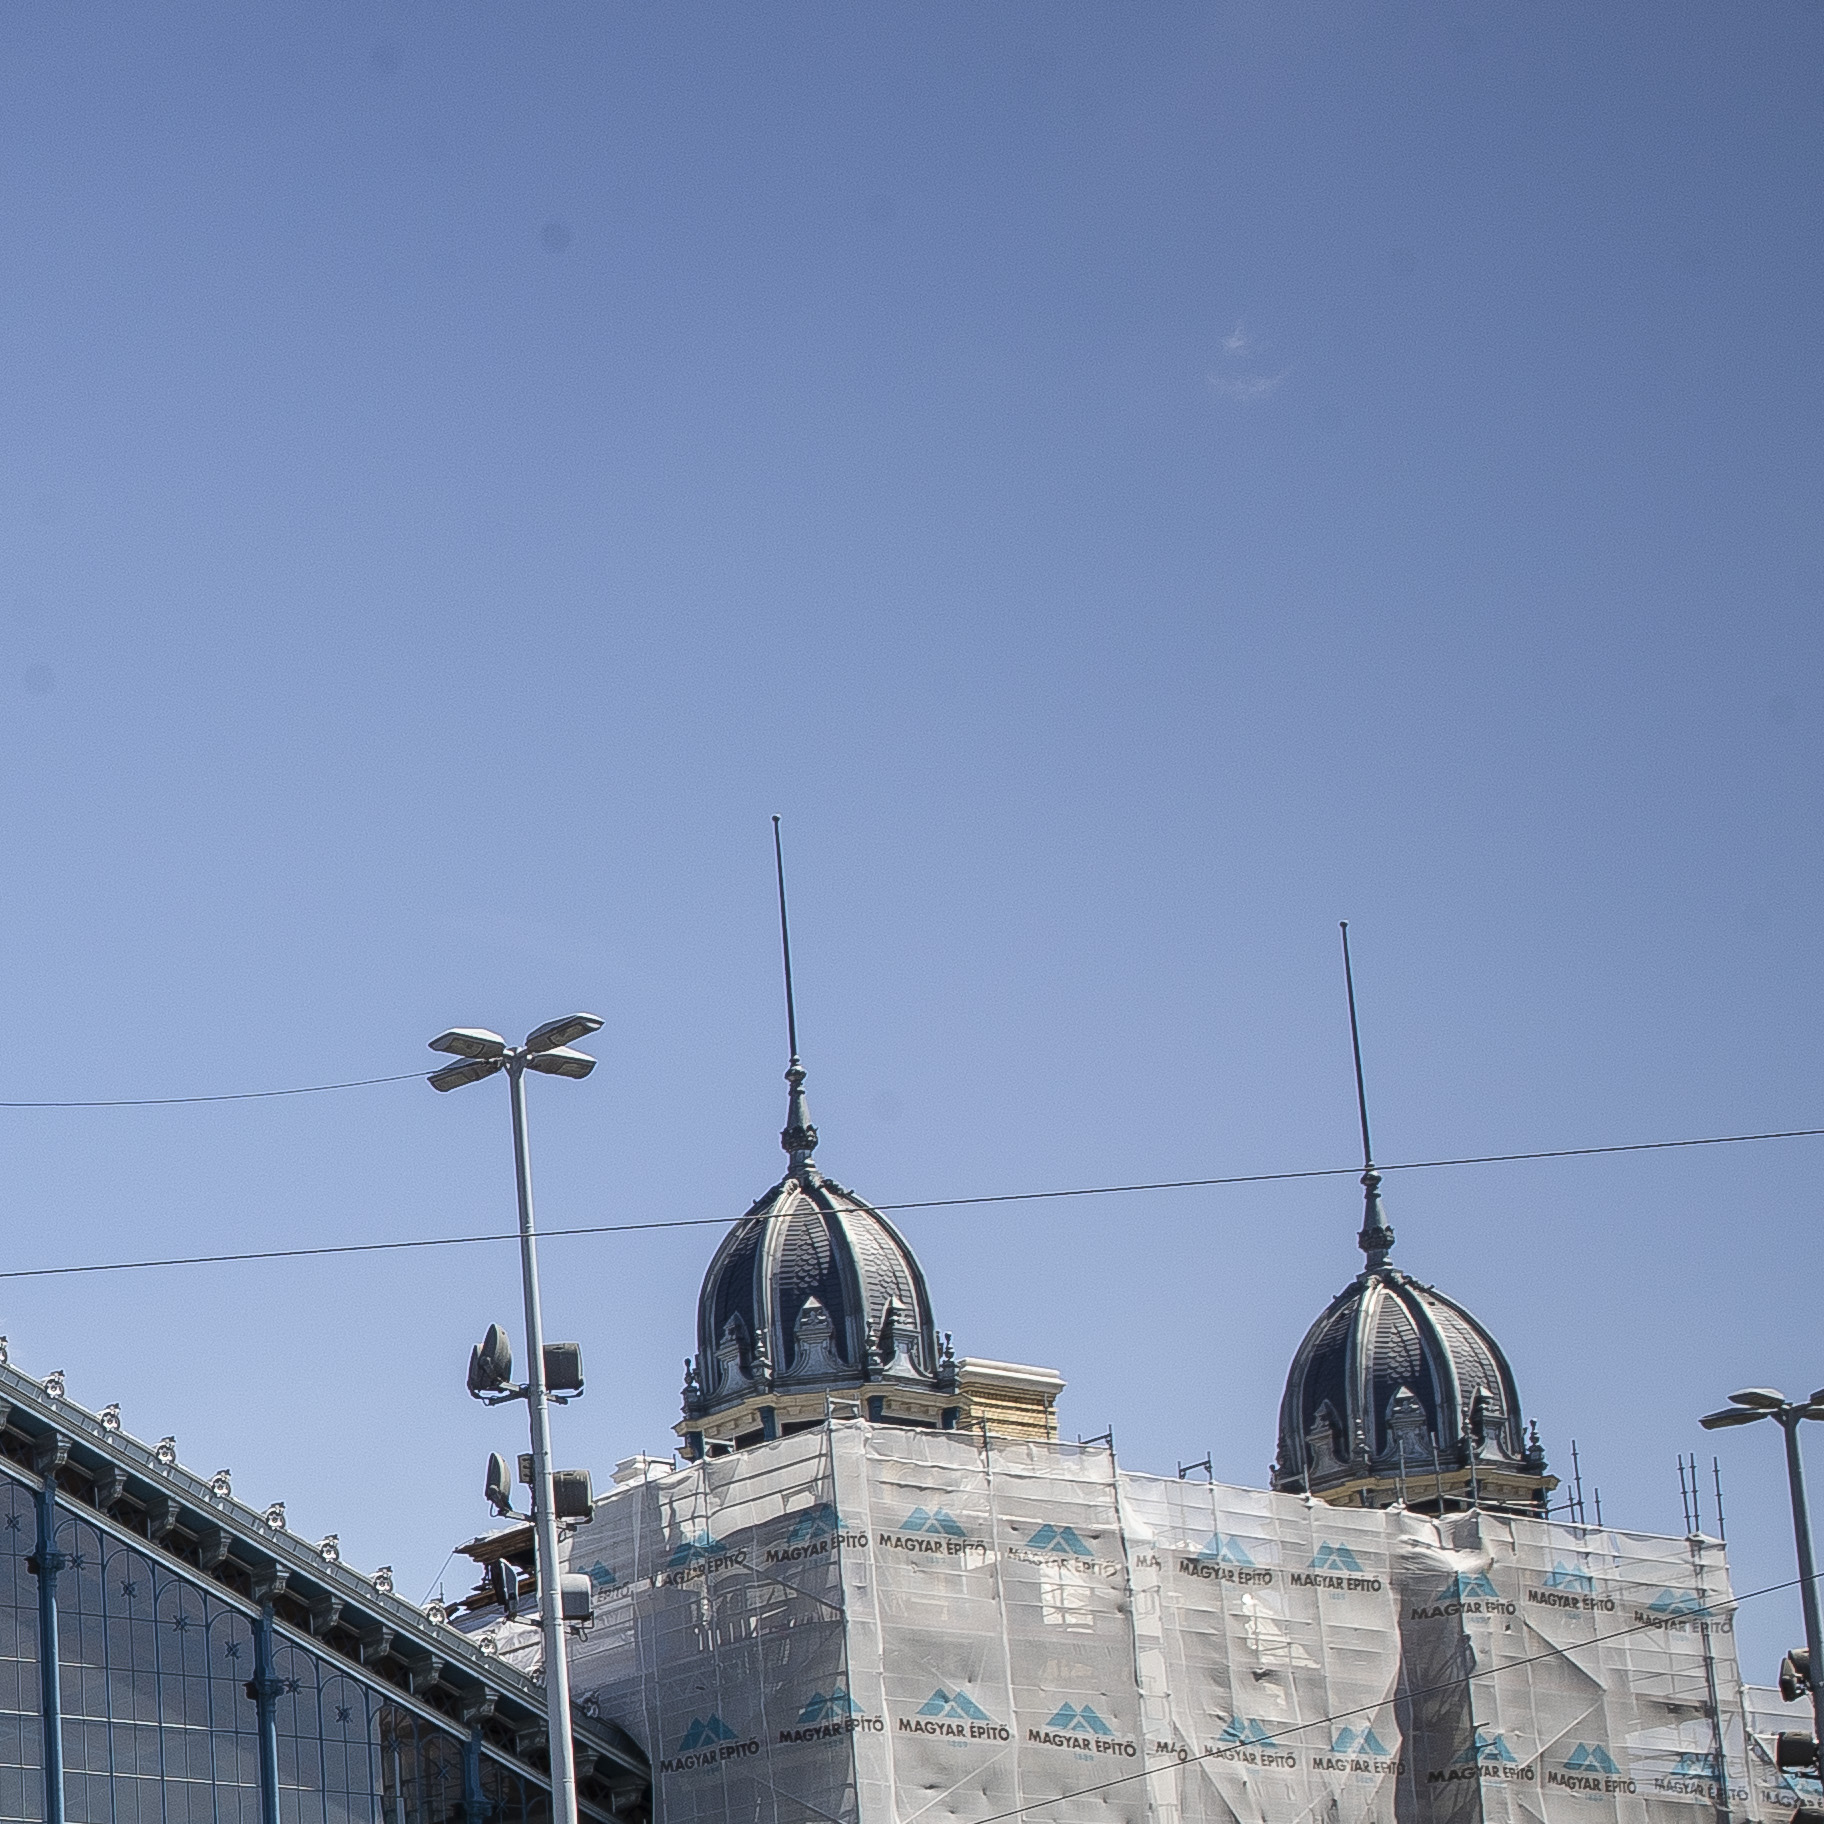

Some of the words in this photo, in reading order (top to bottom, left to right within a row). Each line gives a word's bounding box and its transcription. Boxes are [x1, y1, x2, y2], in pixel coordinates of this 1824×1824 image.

[765, 1540, 828, 1563] MAGYAR
[831, 1529, 869, 1550] ÉPÍTŐ
[879, 1533, 943, 1555] MAGYAR
[946, 1536, 987, 1557] ÉPÍTŐ
[1179, 1560, 1235, 1583] MAGYAR
[1238, 1567, 1273, 1585] ÉPÍTŐ
[1290, 1573, 1344, 1590] MAGYAR
[1347, 1574, 1381, 1592] ÉPÍTŐ
[1410, 1600, 1482, 1621] MAGYAR
[1485, 1597, 1517, 1616] ÉPÍTŐ
[1528, 1589, 1579, 1610] MAGYAR
[1583, 1591, 1616, 1612] ÉPÍTŐ
[778, 1724, 842, 1744] MAGYAR
[845, 1714, 884, 1732] ÉPÍTŐ
[898, 1718, 966, 1738] MAGYAR
[969, 1721, 1010, 1741] ÉPÍTŐ
[659, 1752, 717, 1774] MAGYAR
[719, 1736, 760, 1761] ÉPÍTŐ
[1028, 1729, 1091, 1751] MAGYAR
[1094, 1734, 1137, 1758] ÉPÍTŐ
[1204, 1744, 1256, 1763] MAGYAR
[1260, 1749, 1297, 1770] ÉPÍTŐ
[1312, 1756, 1370, 1774] MAGYAR
[1427, 1764, 1499, 1784] MAGYAR
[1502, 1758, 1535, 1781] ÉPÍTŐ
[1548, 1770, 1601, 1792] MAGYAR
[1604, 1773, 1637, 1796] ÉPÍTŐ
[1654, 1777, 1706, 1798] MAGYAR
